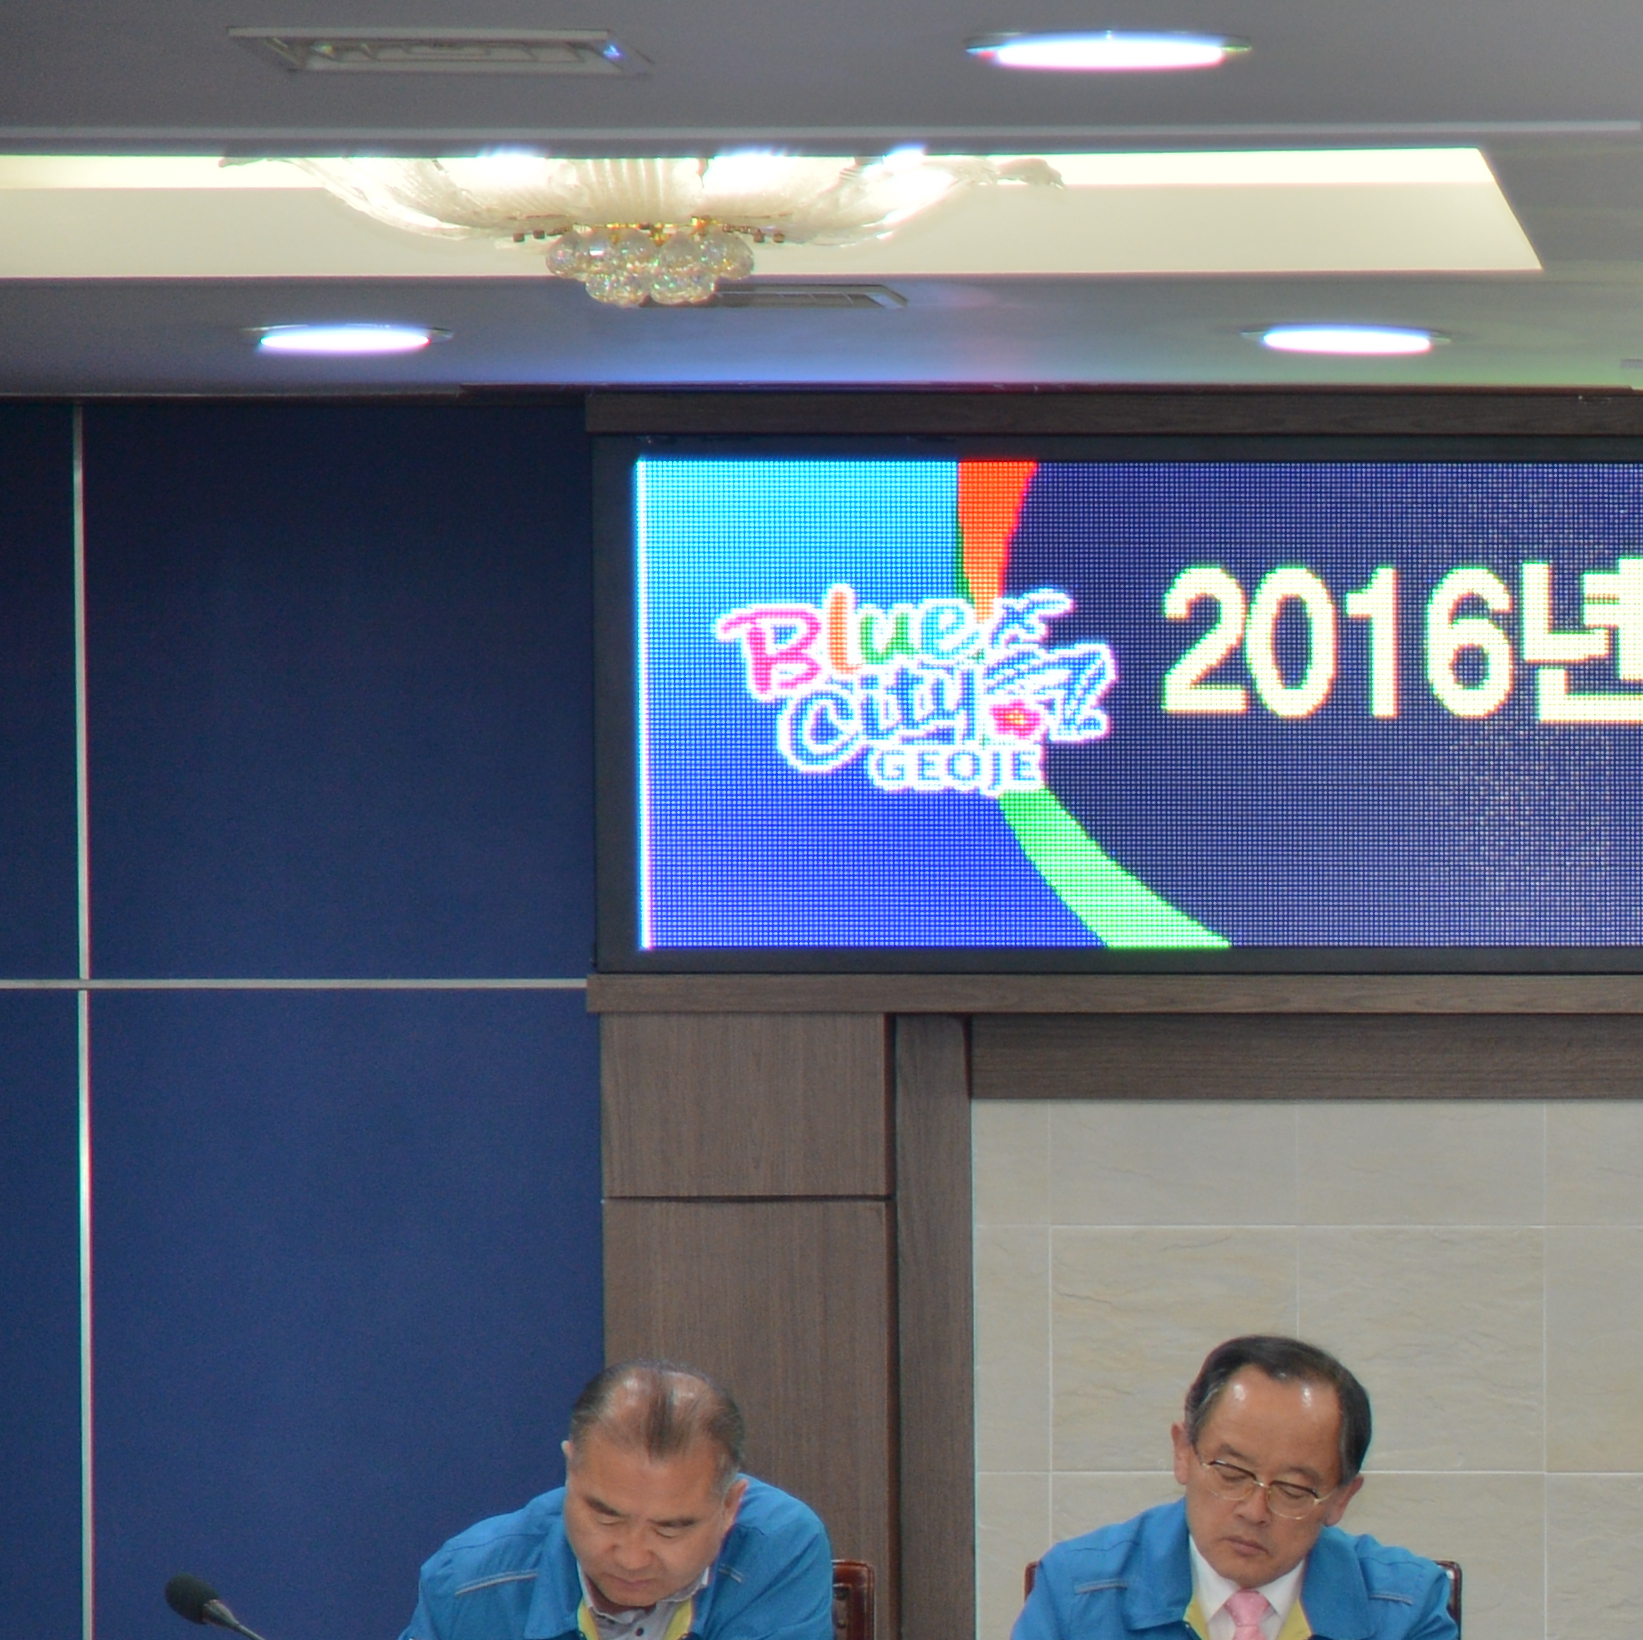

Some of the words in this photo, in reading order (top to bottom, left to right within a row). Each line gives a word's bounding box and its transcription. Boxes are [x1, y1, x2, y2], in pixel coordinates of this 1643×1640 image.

[718, 585, 984, 699] Blue
[780, 660, 982, 768] City
[872, 748, 1040, 793] GEOJE
